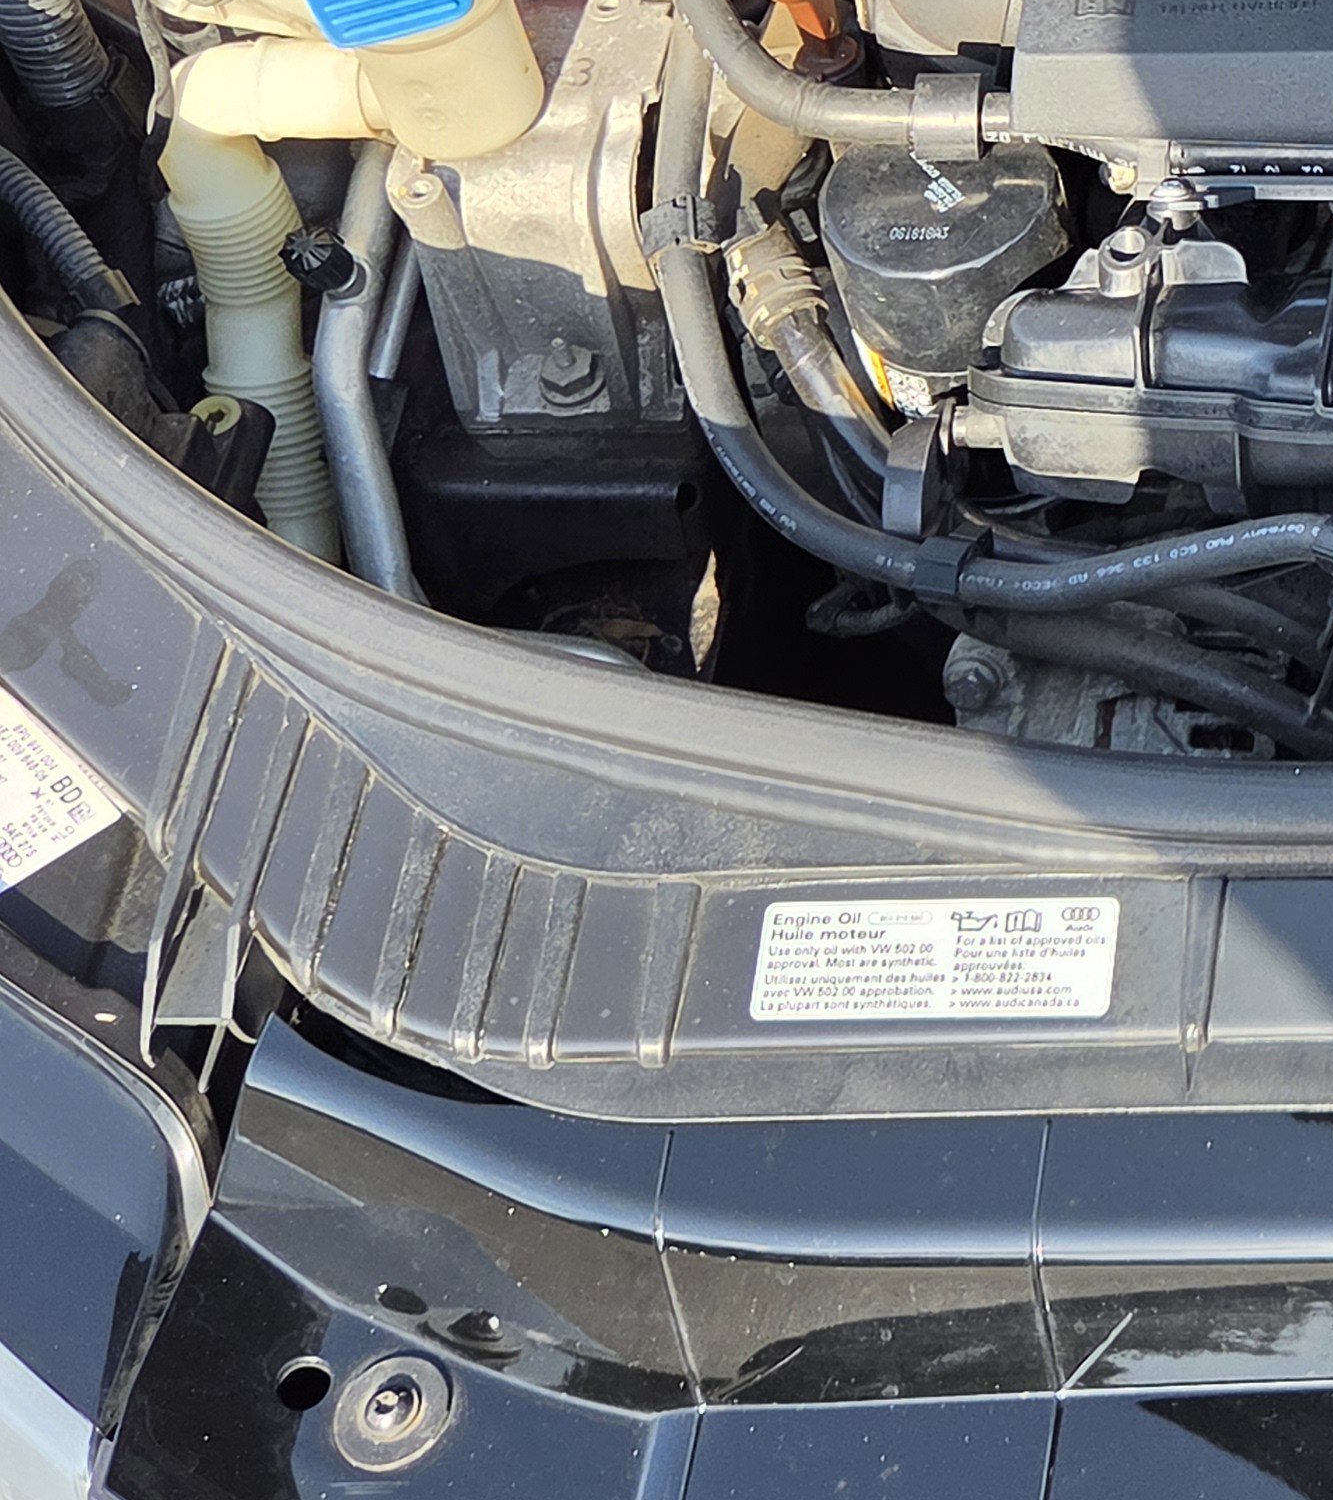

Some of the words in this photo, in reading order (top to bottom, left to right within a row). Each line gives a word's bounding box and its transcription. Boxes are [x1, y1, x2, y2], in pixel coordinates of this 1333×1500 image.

[50, 775, 83, 804] BD
[773, 912, 831, 928] Engine
[838, 912, 862, 925] Oil
[771, 929, 814, 941] Huile
[820, 929, 887, 941] moteur
[956, 935, 976, 946] For
[989, 936, 1007, 945] list
[1010, 935, 1023, 945] of
[1025, 935, 1082, 947] approved
[768, 946, 791, 956] Use
[794, 946, 820, 958] only
[823, 945, 838, 955] oil
[841, 944, 867, 955] with
[871, 944, 892, 954] VW
[895, 943, 916, 954] 502
[919, 943, 934, 953] 00
[954, 948, 982, 958] Pour
[986, 950, 1008, 958] une
[1011, 948, 1036, 958] liste
[825, 957, 855, 968] Most
[859, 959, 878, 968] are
[765, 973, 807, 985] Utilisez
[811, 974, 882, 986] uniquement
[885, 973, 906, 983] des
[910, 972, 946, 983] huiles
[763, 988, 789, 998] avec
[793, 987, 815, 997] VW
[960, 985, 1072, 995] www.audiusa.com
[760, 1001, 774, 1011] La
[777, 1000, 820, 1012] plupart
[823, 1000, 849, 1010] sont
